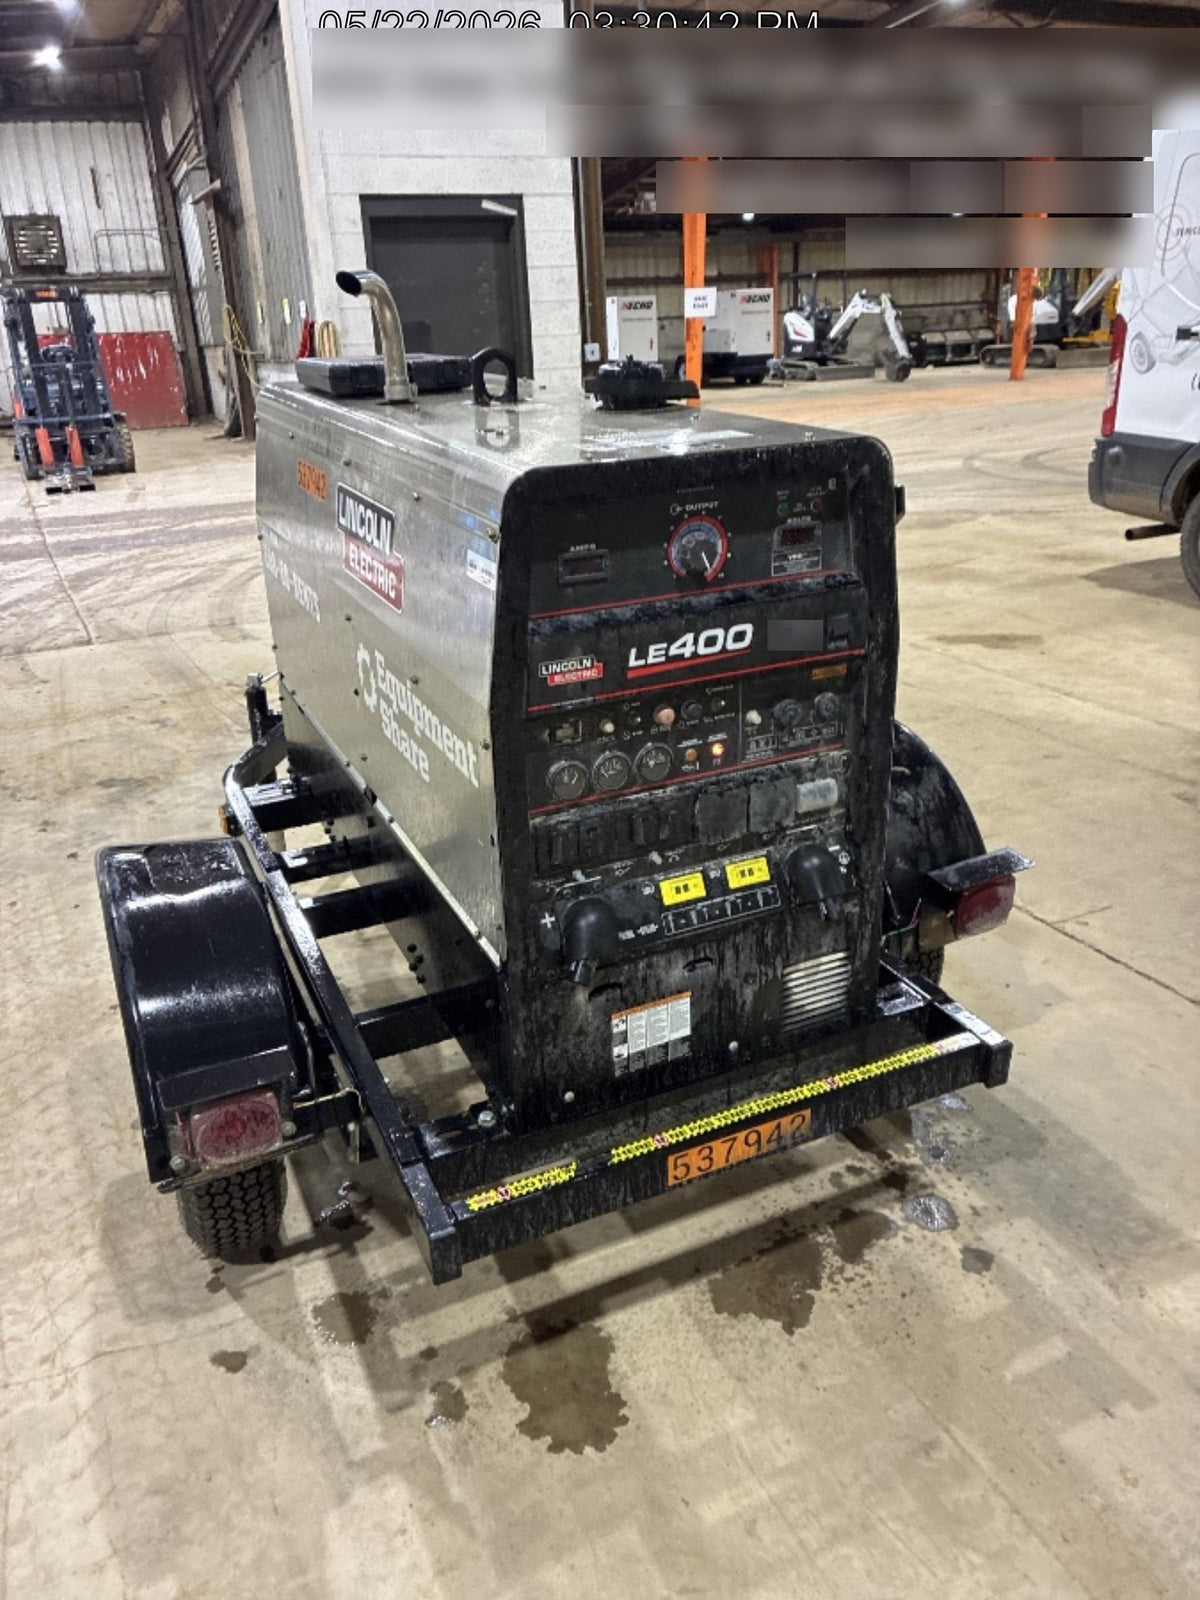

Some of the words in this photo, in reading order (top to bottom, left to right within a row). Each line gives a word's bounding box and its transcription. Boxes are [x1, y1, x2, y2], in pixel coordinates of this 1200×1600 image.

[339, 492, 392, 556] LINCOLN
[685, 501, 719, 512] OUTPUT
[349, 543, 397, 600] ELECTRIC
[541, 657, 592, 675] LINCOLN
[628, 623, 754, 667] LE400
[554, 668, 598, 683] ELECTRIC
[374, 649, 479, 788] Equipment
[380, 698, 430, 783] Share
[672, 1113, 807, 1182] 537942
